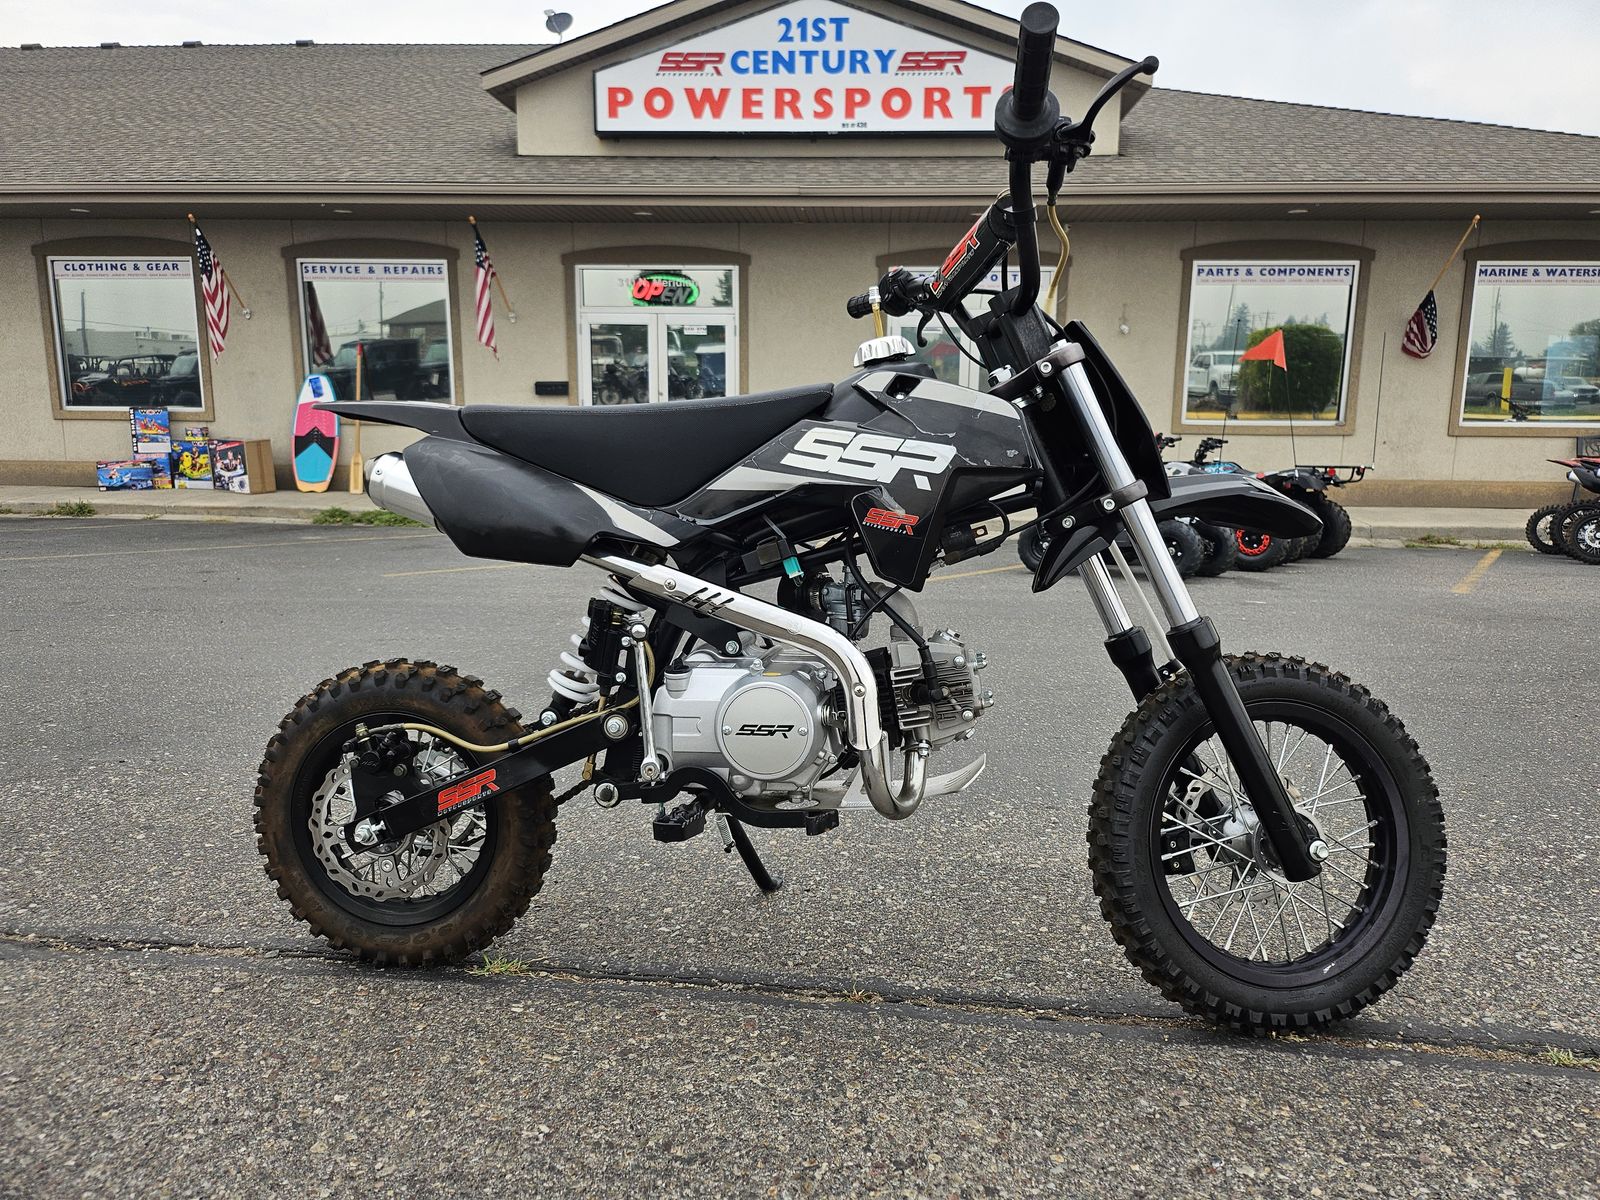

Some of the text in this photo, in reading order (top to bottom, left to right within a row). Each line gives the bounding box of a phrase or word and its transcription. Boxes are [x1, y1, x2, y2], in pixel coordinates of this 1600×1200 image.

[778, 17, 850, 43] 21ST
[658, 52, 726, 76] SSR
[730, 49, 897, 75] CENTURY
[897, 51, 967, 75] SSR
[607, 86, 1014, 119] POWERSPORT
[63, 262, 180, 271] CLOTHING & GEAR
[303, 265, 444, 275] SERVICE & REPAIRS
[1197, 268, 1351, 277] PARTS & COMPONENTS
[1478, 268, 1528, 277] MARINE
[1531, 268, 1541, 277] &
[632, 278, 692, 305] OPEN
[780, 427, 957, 491] SSR
[863, 507, 920, 536] SSR
[735, 724, 795, 739] SSR
[437, 768, 500, 812] SSR
